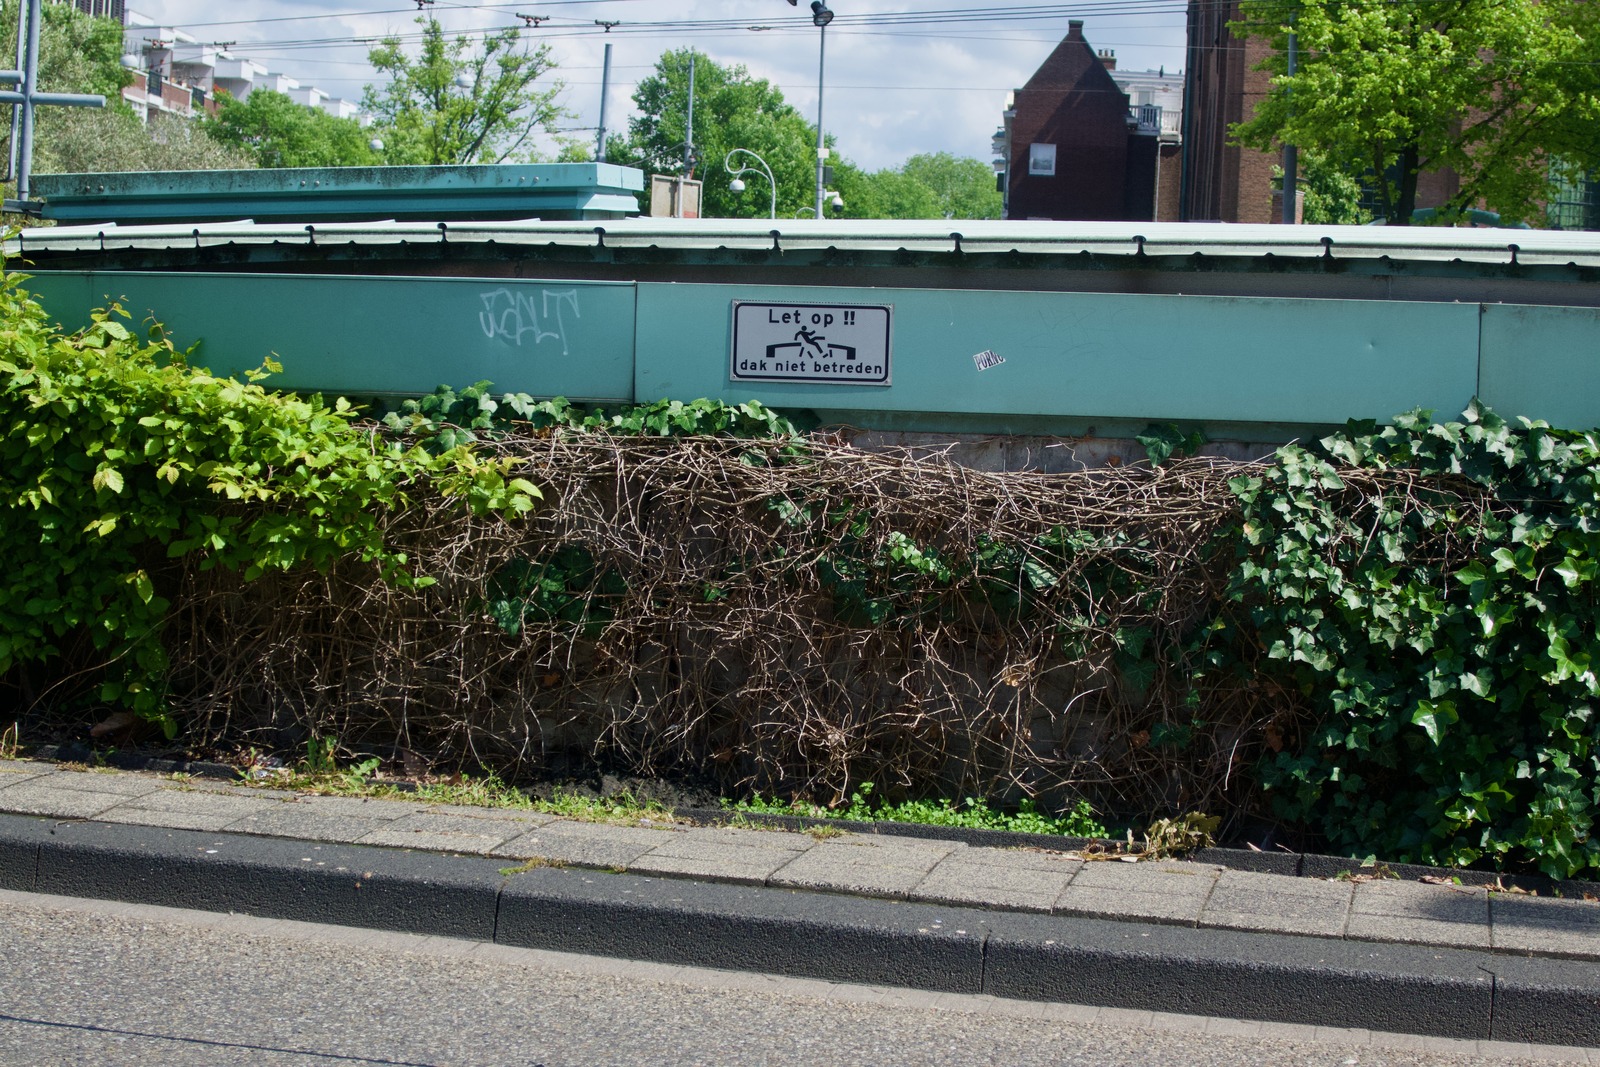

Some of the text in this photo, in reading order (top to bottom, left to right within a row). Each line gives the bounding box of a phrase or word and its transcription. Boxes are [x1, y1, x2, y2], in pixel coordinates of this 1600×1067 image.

[768, 309, 855, 328] Let op !!
[740, 359, 882, 375] dak niet betreden
